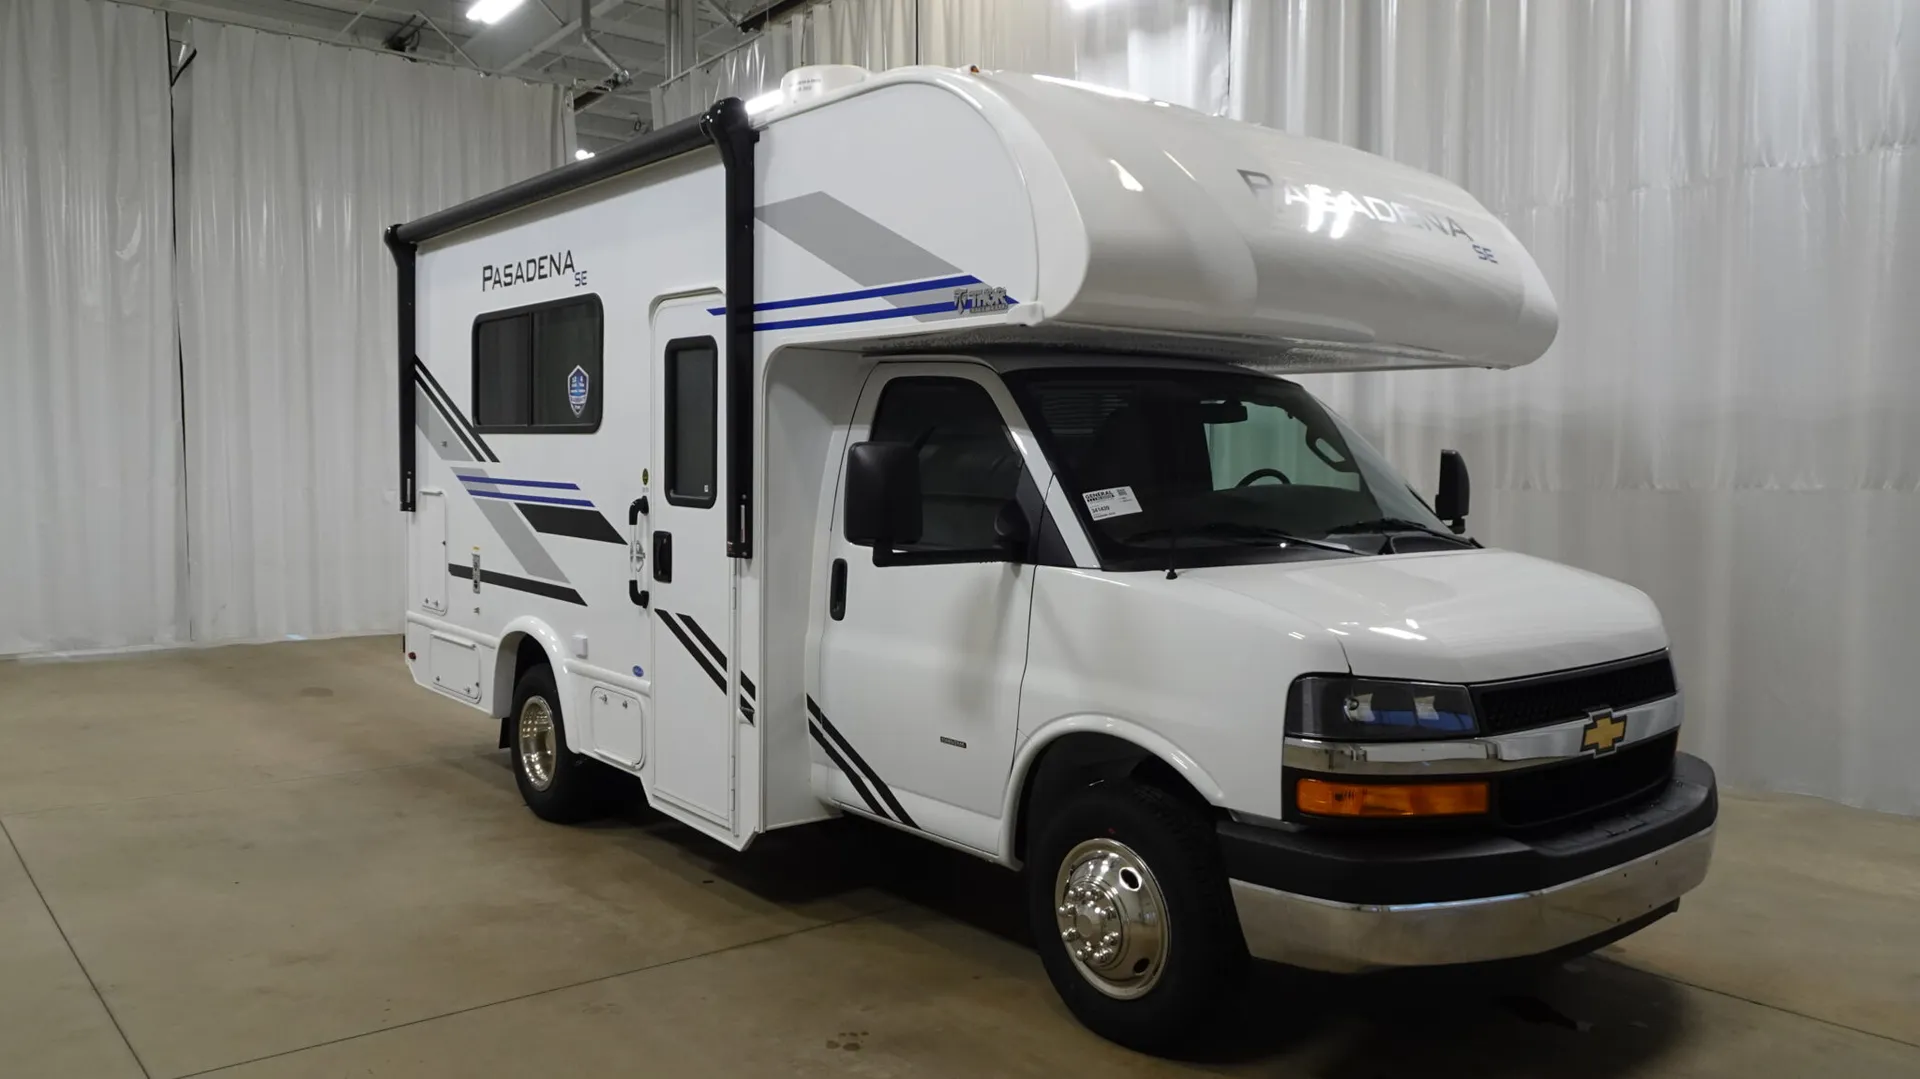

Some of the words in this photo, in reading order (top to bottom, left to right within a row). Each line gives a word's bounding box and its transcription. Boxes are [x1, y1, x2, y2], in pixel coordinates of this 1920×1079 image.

[1472, 244, 1499, 265] SE
[482, 250, 575, 292] PASADENA
[574, 270, 588, 287] SE
[1085, 490, 1113, 500] GENERAL
